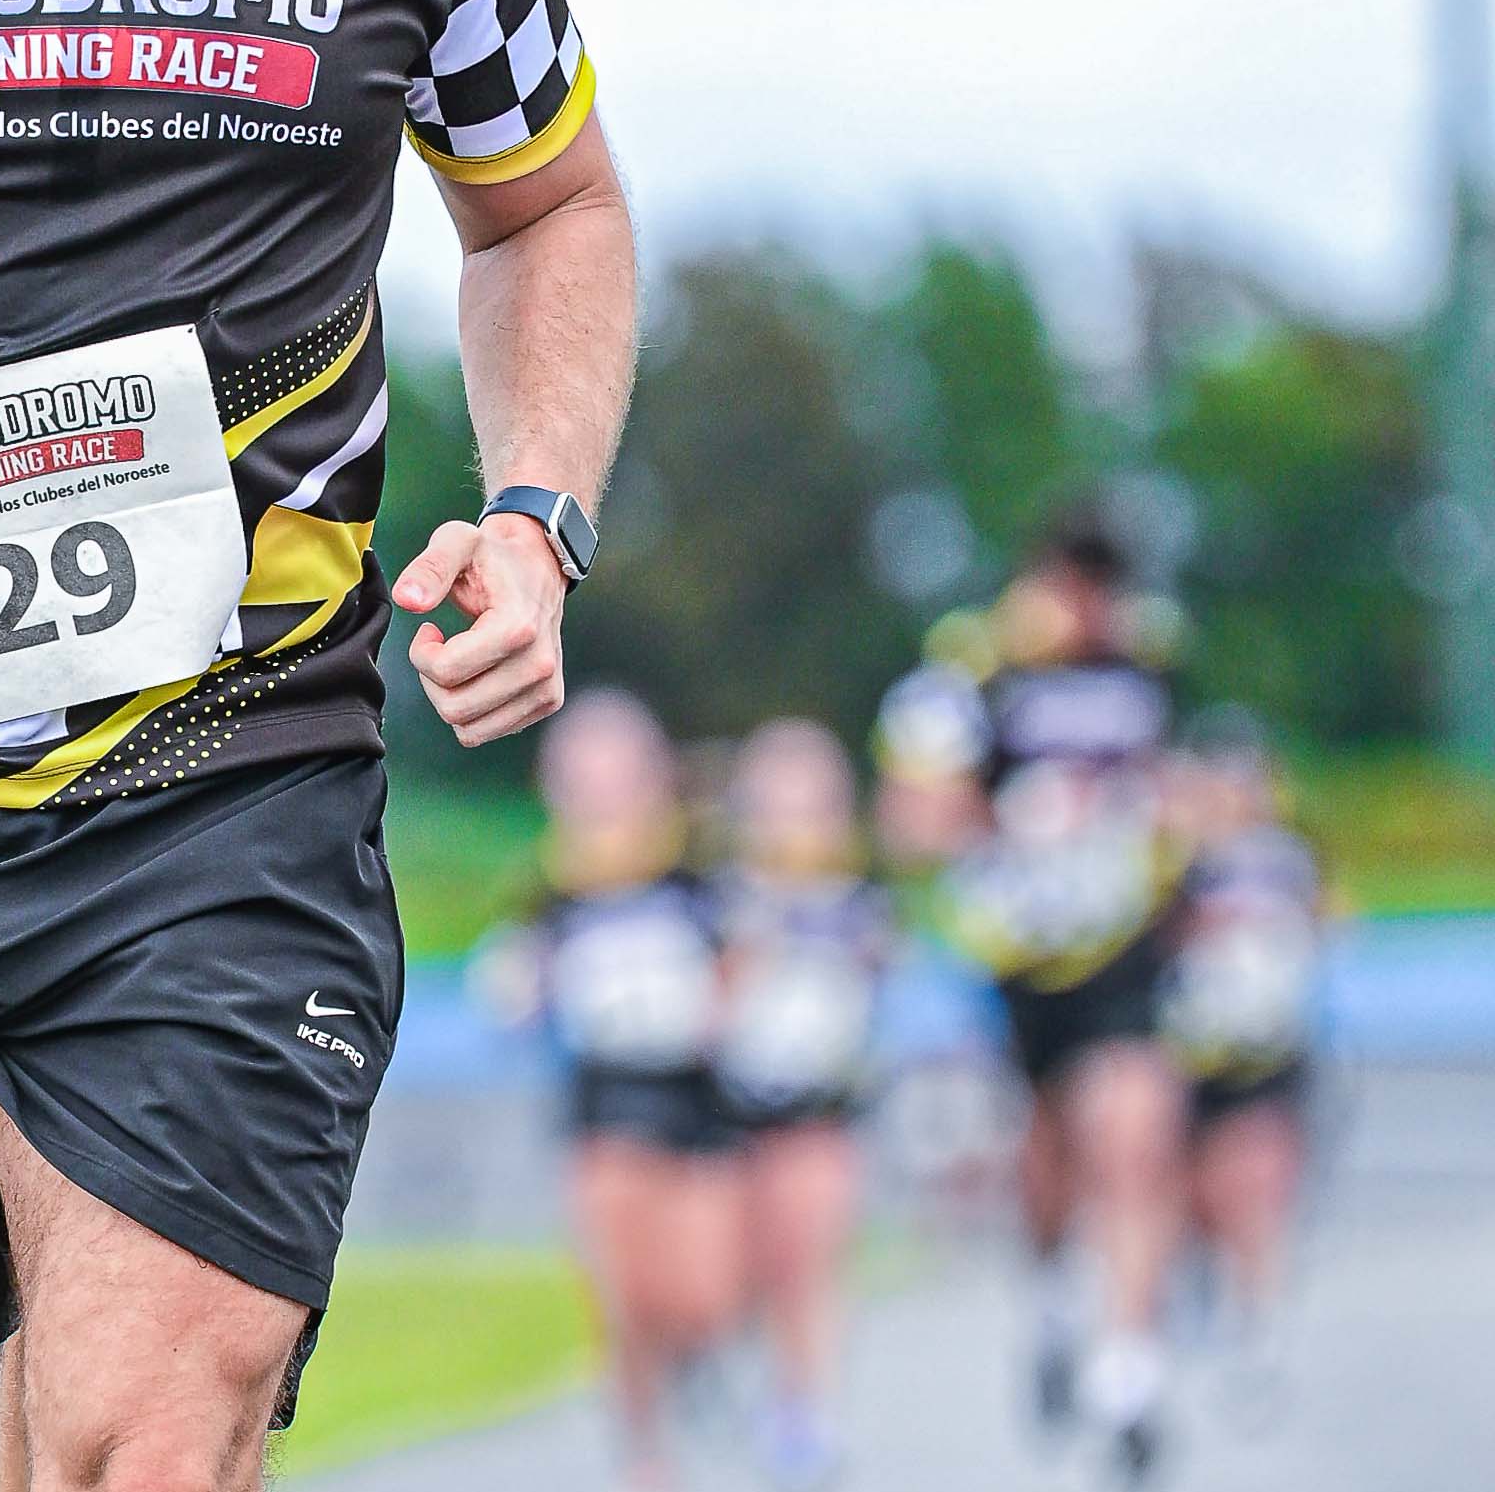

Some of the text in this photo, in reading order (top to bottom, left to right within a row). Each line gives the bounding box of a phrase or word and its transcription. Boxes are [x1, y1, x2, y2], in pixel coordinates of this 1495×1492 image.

[130, 38, 265, 95] RACE
[49, 112, 154, 139] Clubes
[162, 113, 208, 141] del
[219, 114, 343, 147] Noroeste
[50, 436, 117, 468] RACE
[23, 486, 74, 507] Clubes
[77, 475, 101, 494] del
[103, 462, 170, 487] Noroeste
[329, 1037, 365, 1069] PRO
